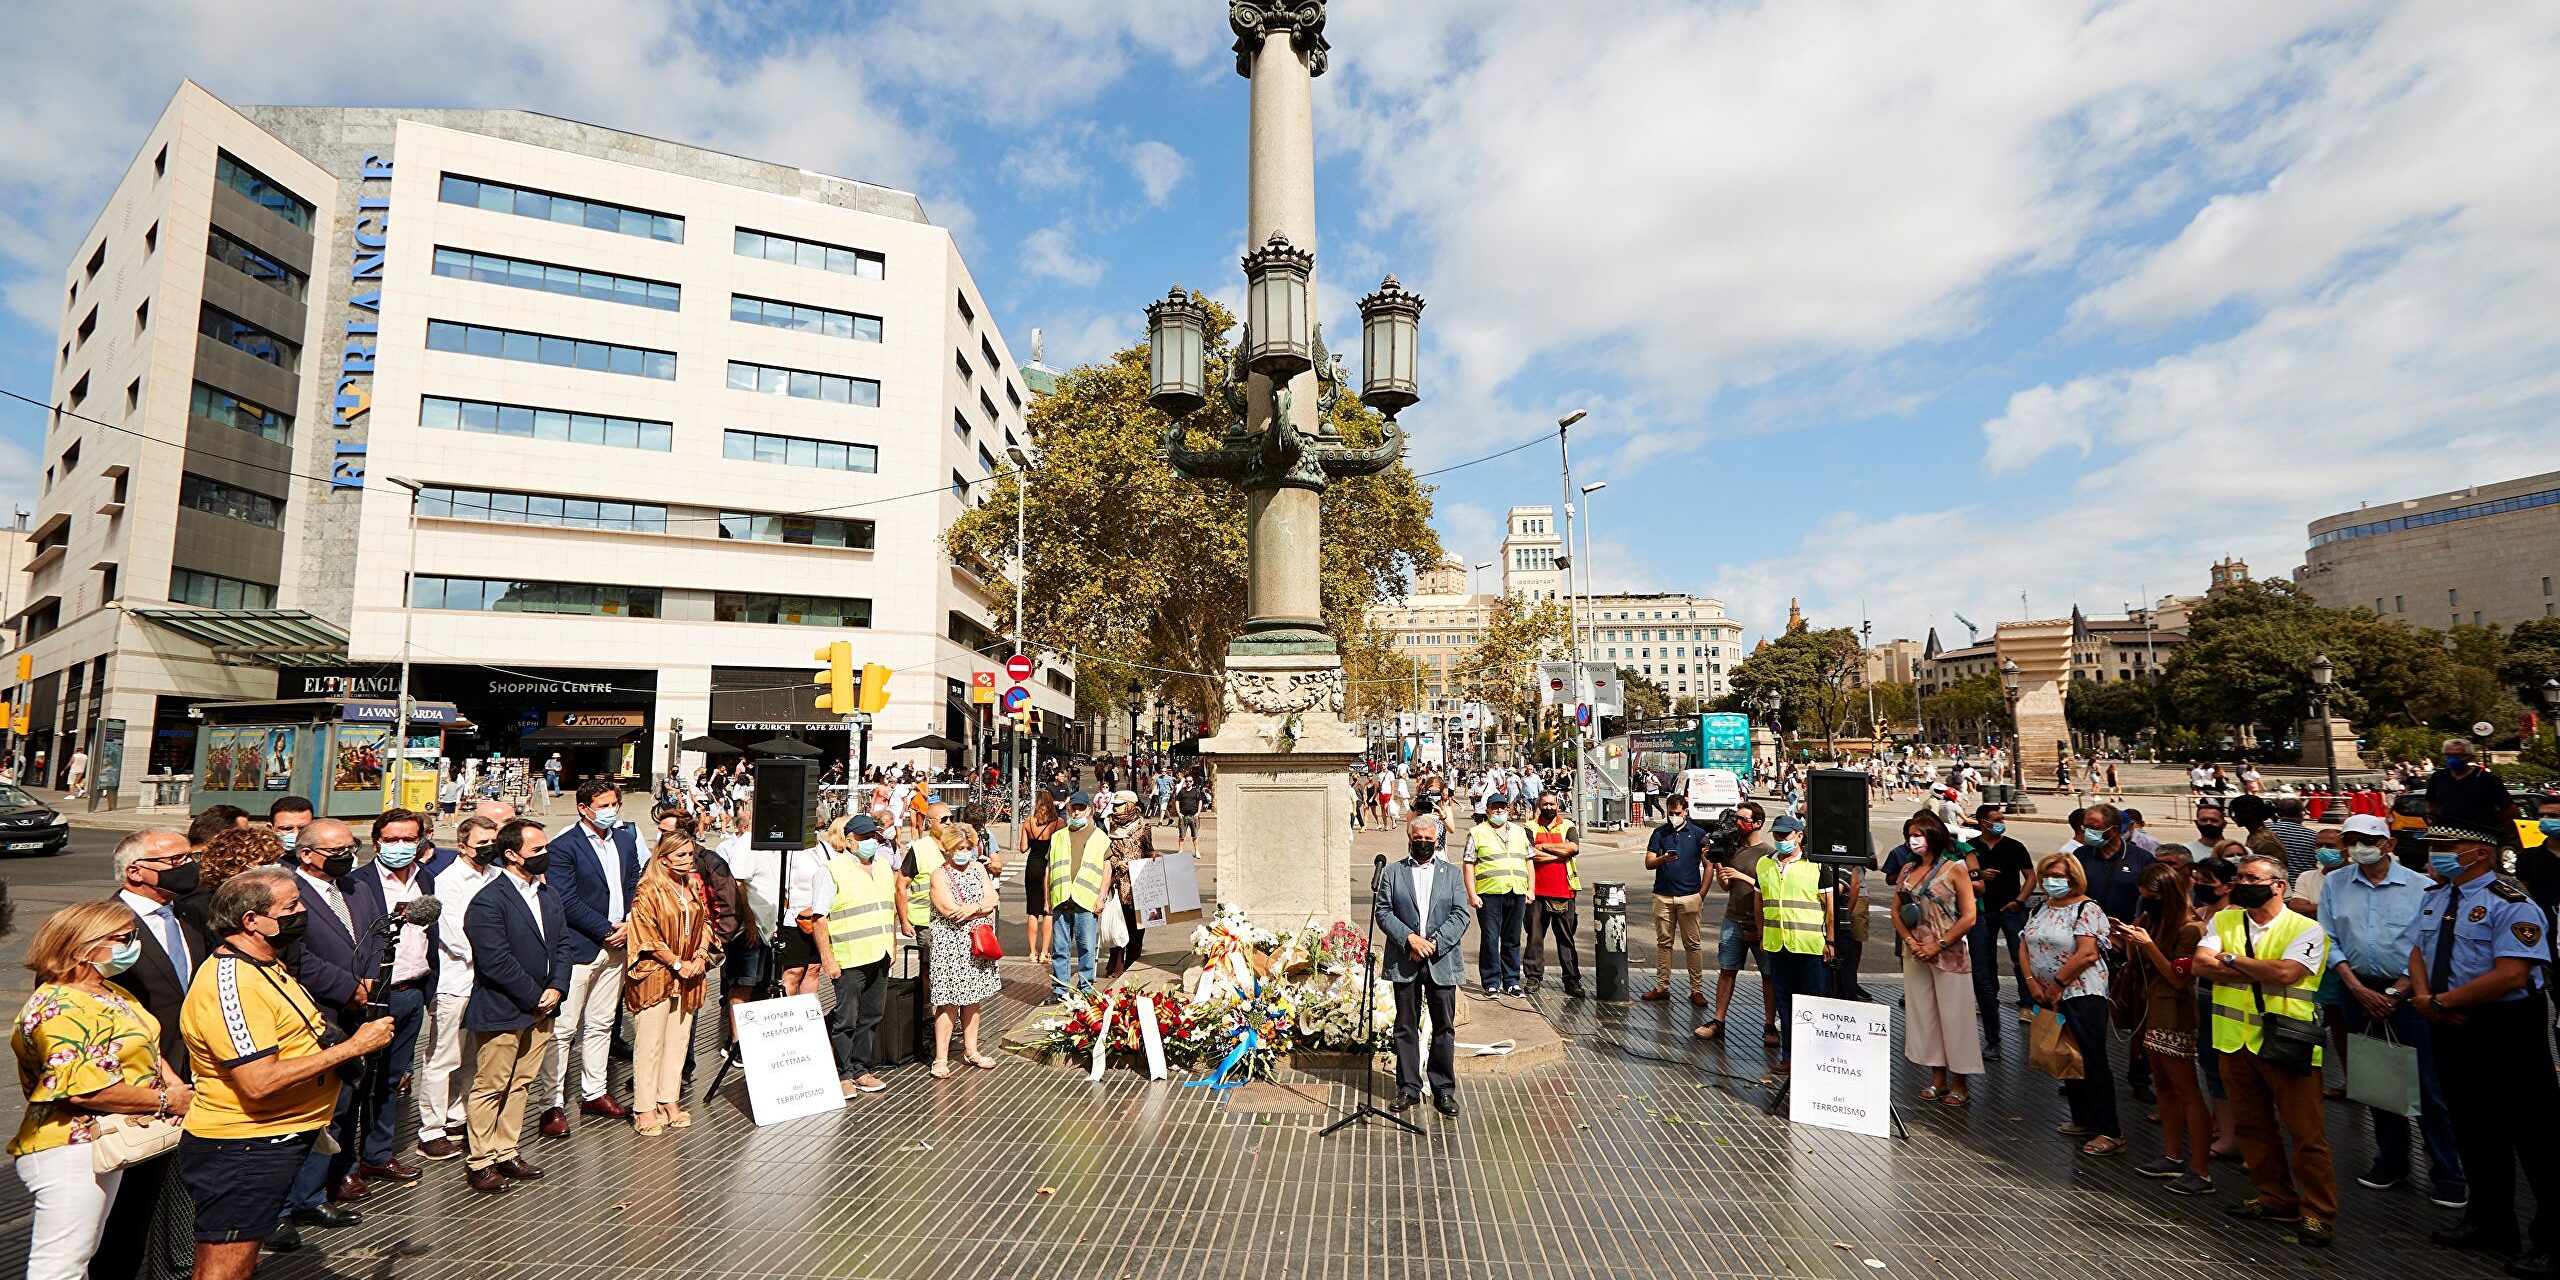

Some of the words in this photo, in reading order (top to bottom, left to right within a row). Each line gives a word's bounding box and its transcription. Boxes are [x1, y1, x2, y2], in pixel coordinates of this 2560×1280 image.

[373, 707, 443, 720] VANARDIA
[579, 713, 627, 726] Amorino
[734, 723, 757, 731] CAFE
[759, 723, 791, 731] ZURICH
[764, 1010, 795, 1021] HONRA
[1822, 1012, 1857, 1024] HONRA
[762, 1025, 804, 1039] MEMORIA
[1816, 1029, 1862, 1042] MEMORIA
[776, 1087, 825, 1105] TERRORISMO
[1833, 1095, 1845, 1103] del
[1812, 1102, 1866, 1118] TERRORISMO
